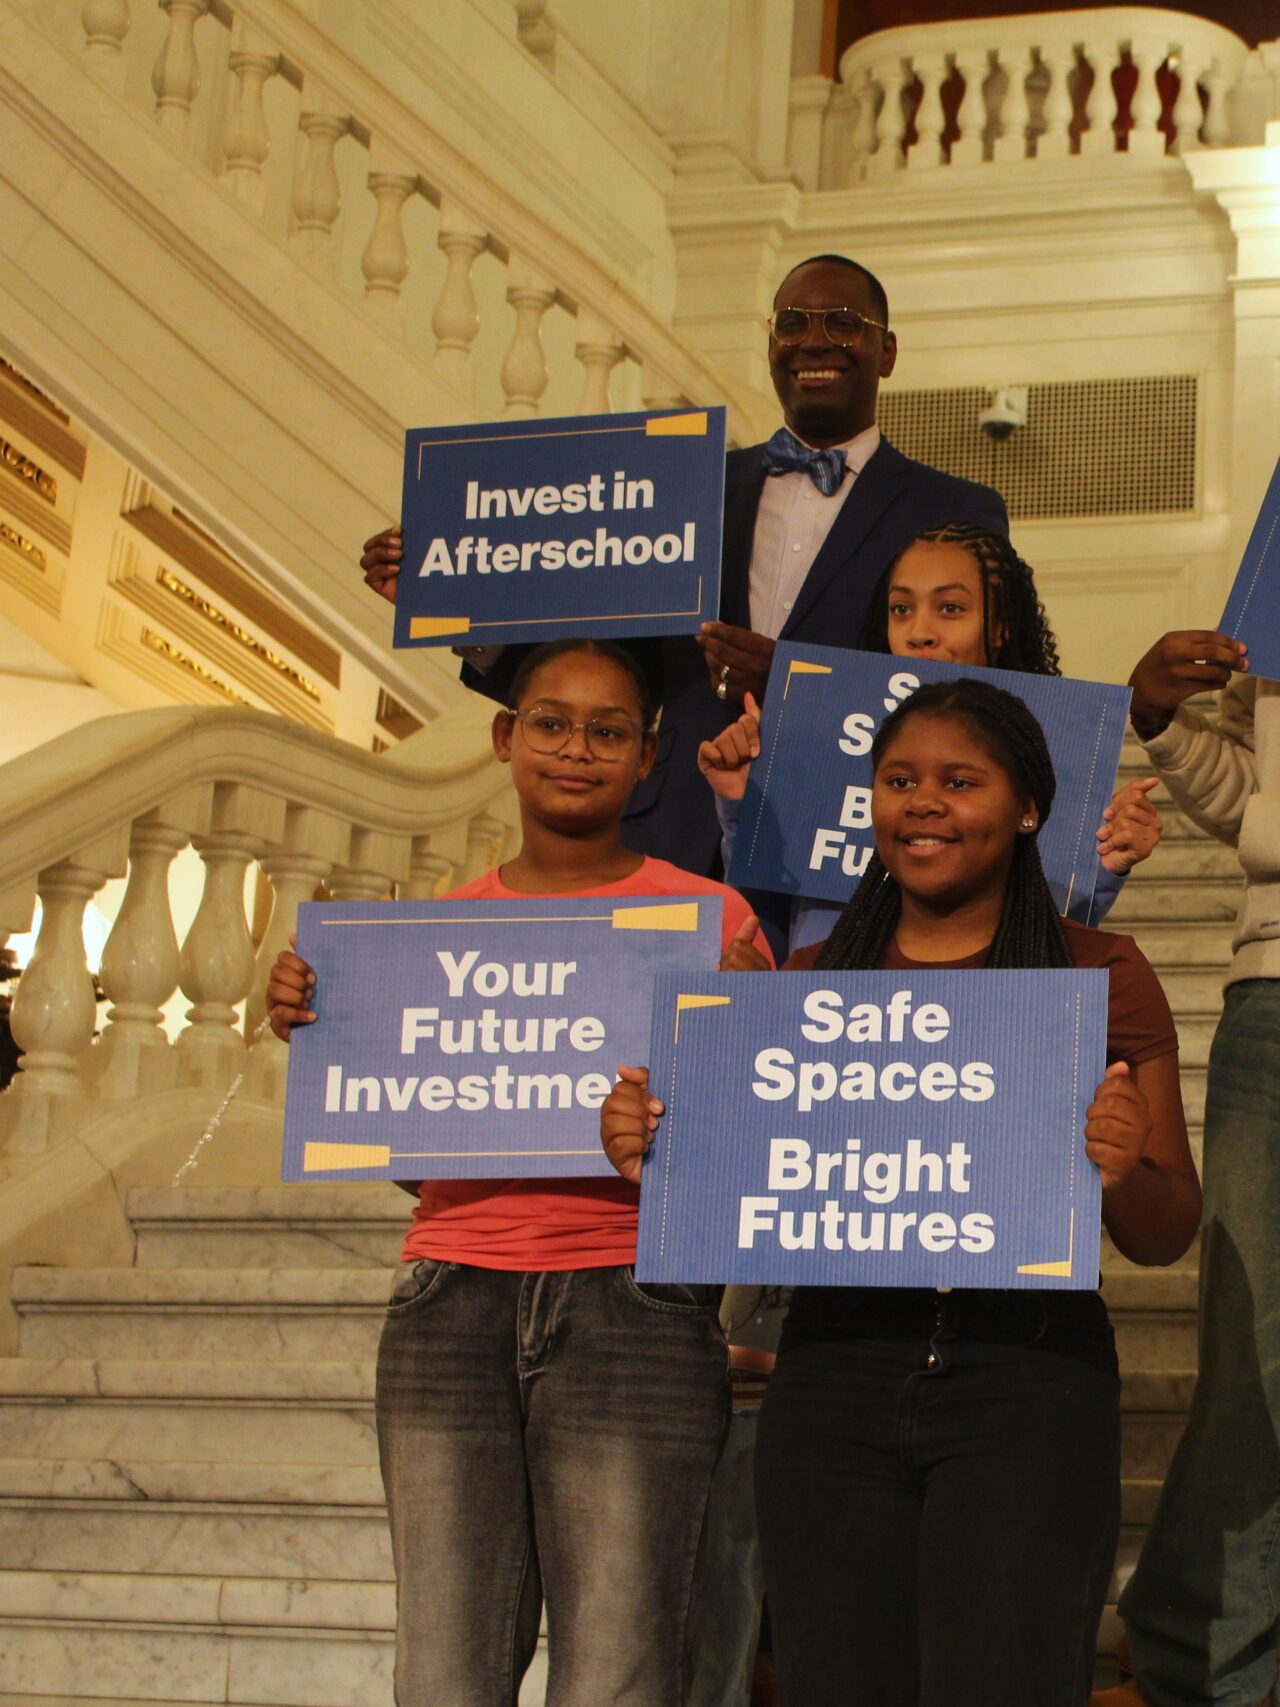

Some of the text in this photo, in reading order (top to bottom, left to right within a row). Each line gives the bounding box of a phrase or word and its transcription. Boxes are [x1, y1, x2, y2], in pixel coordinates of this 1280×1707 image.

[465, 470, 655, 520] Invest in
[418, 522, 696, 578] Afterschool
[436, 950, 577, 998] Your
[400, 1007, 606, 1055] Future
[800, 989, 951, 1044] Safe
[324, 1064, 624, 1113] Investme
[751, 1047, 996, 1112] Spaces
[767, 1138, 972, 1204] Bright
[737, 1196, 996, 1254] Futures
